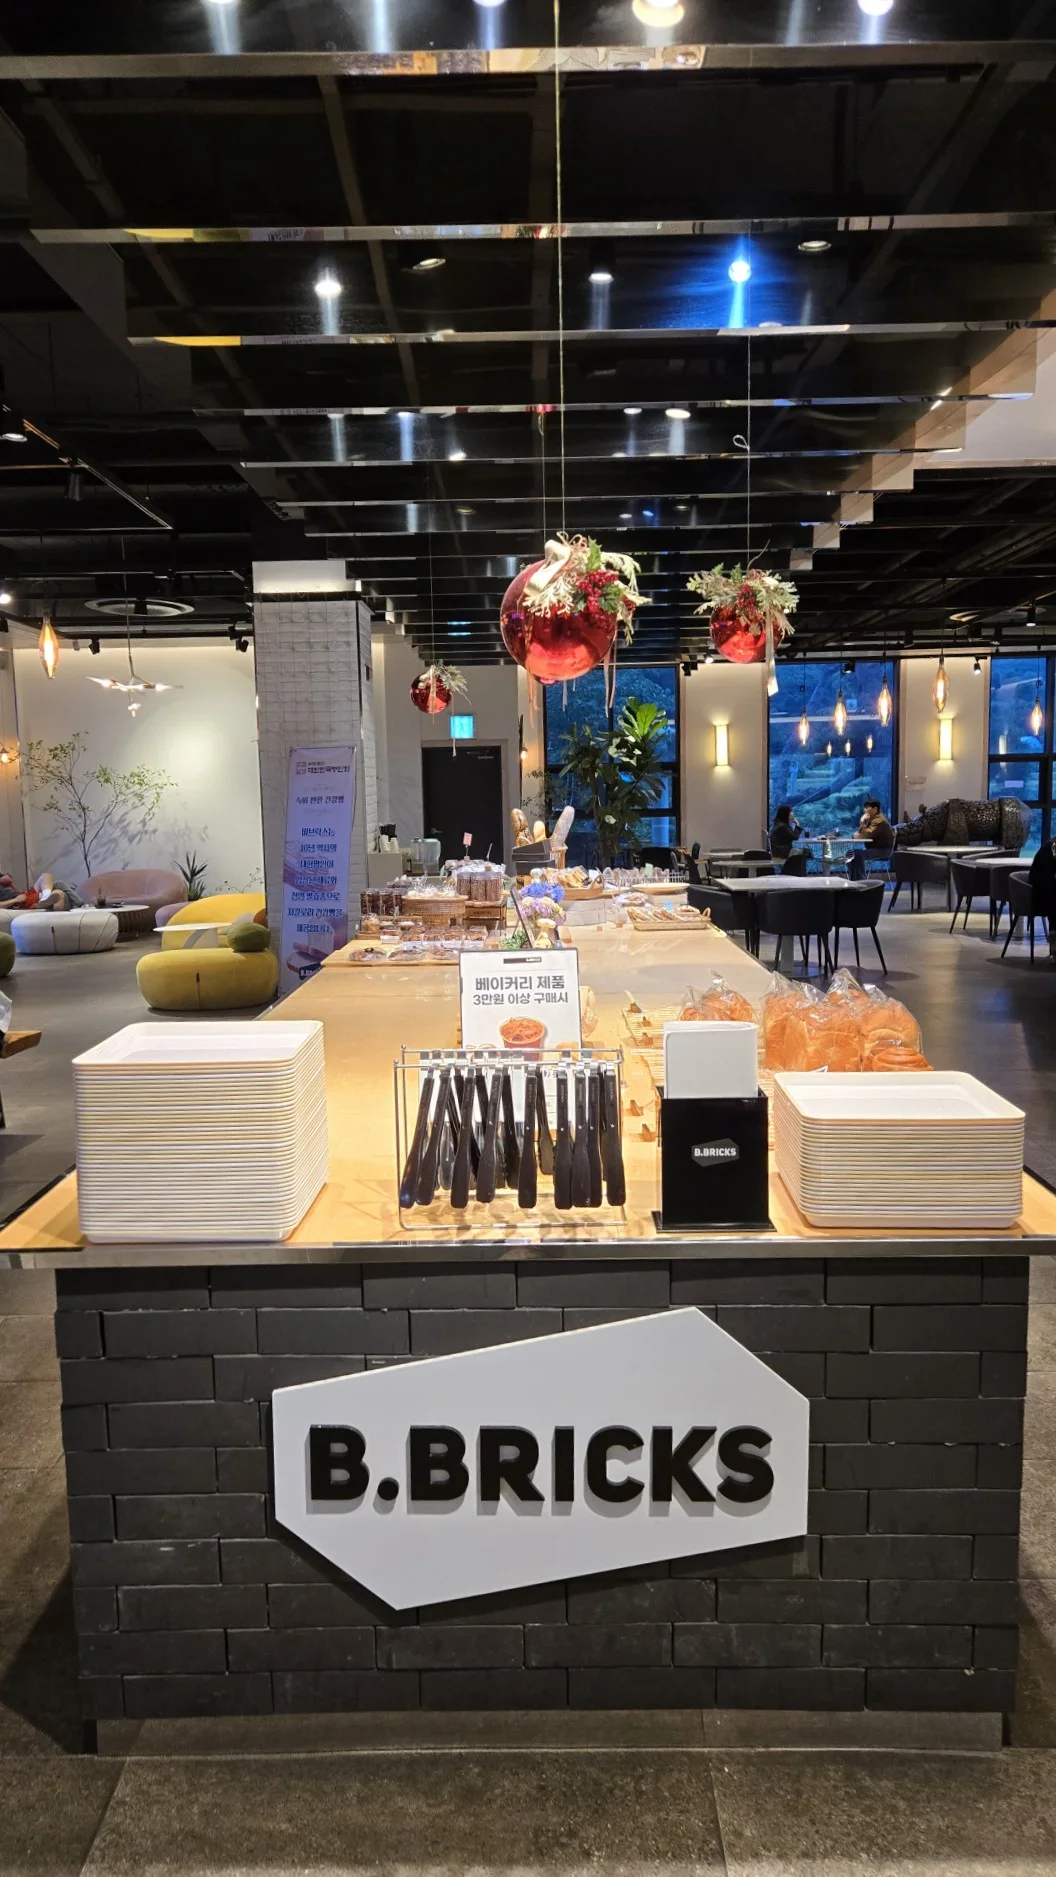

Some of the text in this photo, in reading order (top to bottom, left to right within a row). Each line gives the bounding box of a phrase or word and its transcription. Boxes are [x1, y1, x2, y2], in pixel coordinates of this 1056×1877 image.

[475, 975, 565, 991] 베이커리 제품
[473, 991, 569, 1006] 3만원 이상 구매시
[694, 1147, 737, 1157] B.BRICKS
[309, 1424, 775, 1503] B.BRICKS
